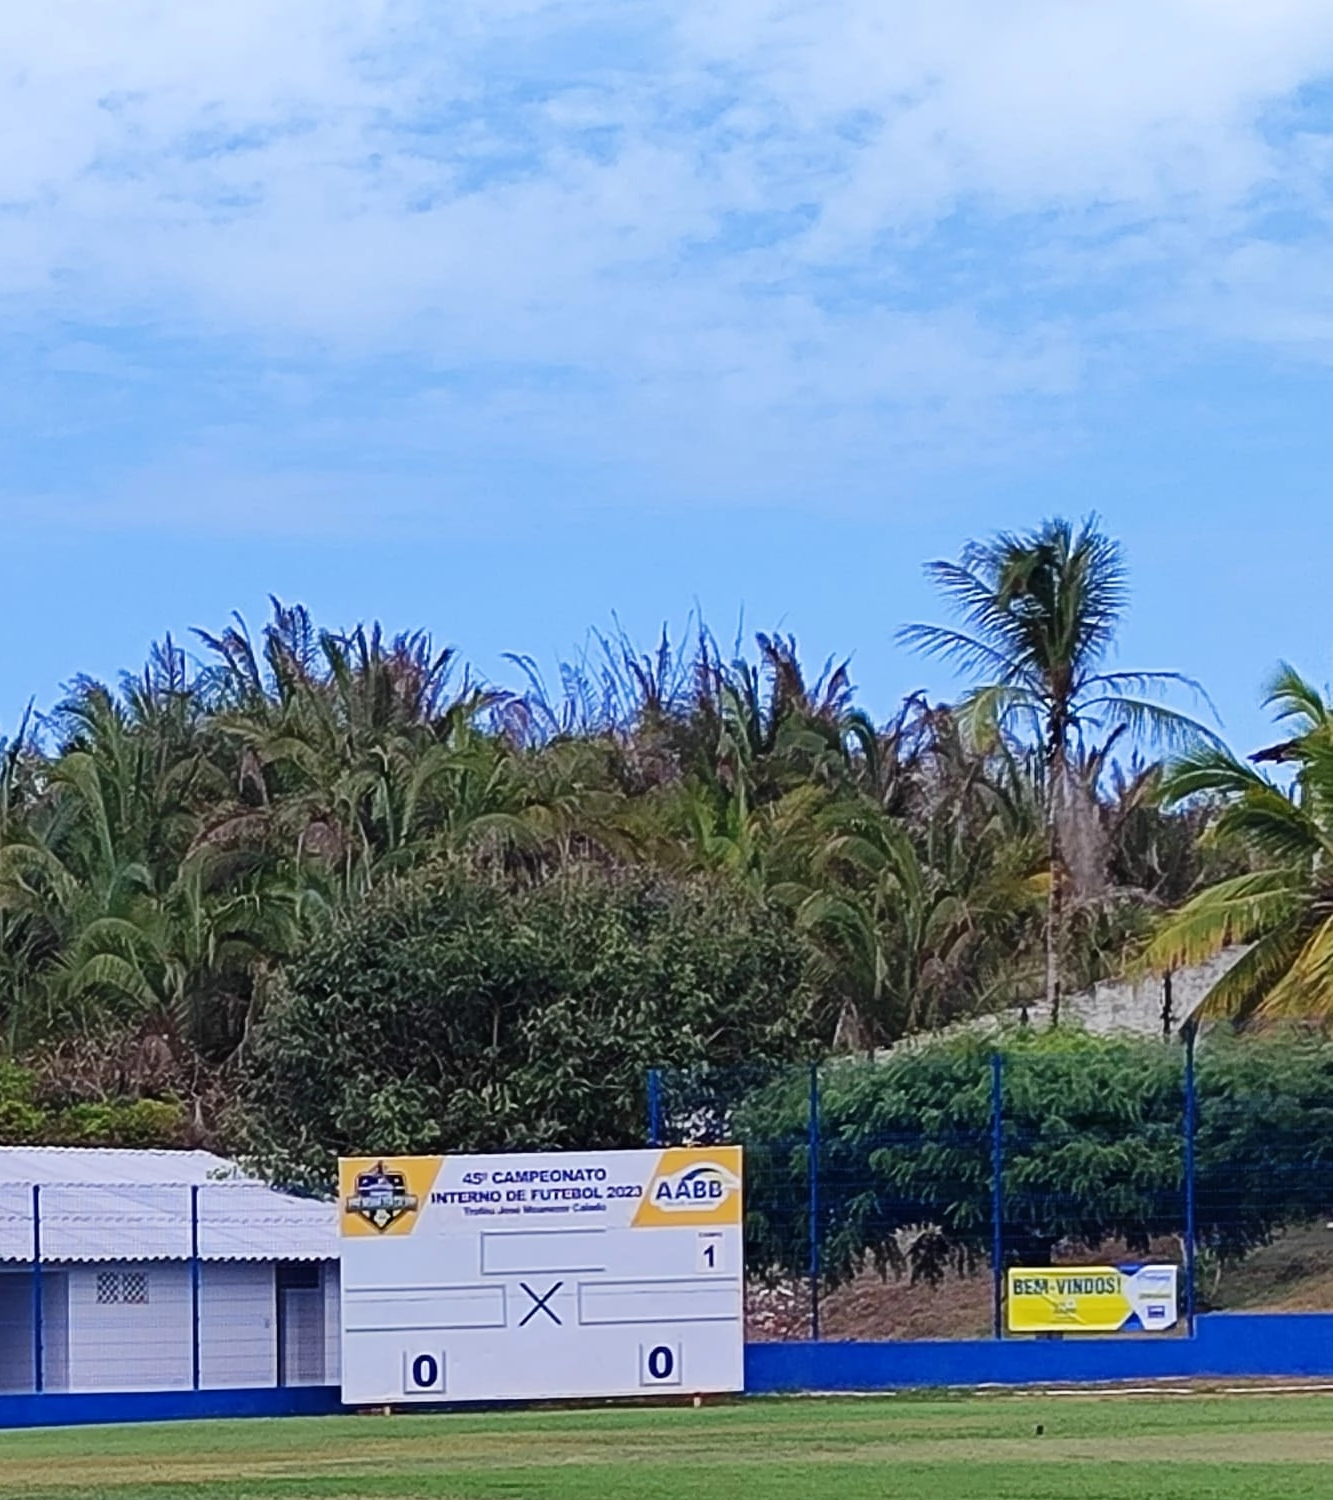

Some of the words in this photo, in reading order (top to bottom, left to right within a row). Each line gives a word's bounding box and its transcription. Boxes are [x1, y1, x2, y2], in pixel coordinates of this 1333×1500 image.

[492, 1168, 607, 1184] CAMPEONATO
[431, 1189, 501, 1204] INTERNO
[506, 1189, 526, 1202] DE
[532, 1186, 602, 1201] FUTEBOL
[606, 1185, 643, 1199] 2023
[655, 1180, 723, 1200] AABB
[703, 1244, 714, 1267] 1
[1013, 1277, 1122, 1295] BEM-VINDOS!
[412, 1354, 438, 1388] 0
[648, 1346, 674, 1379] 0
